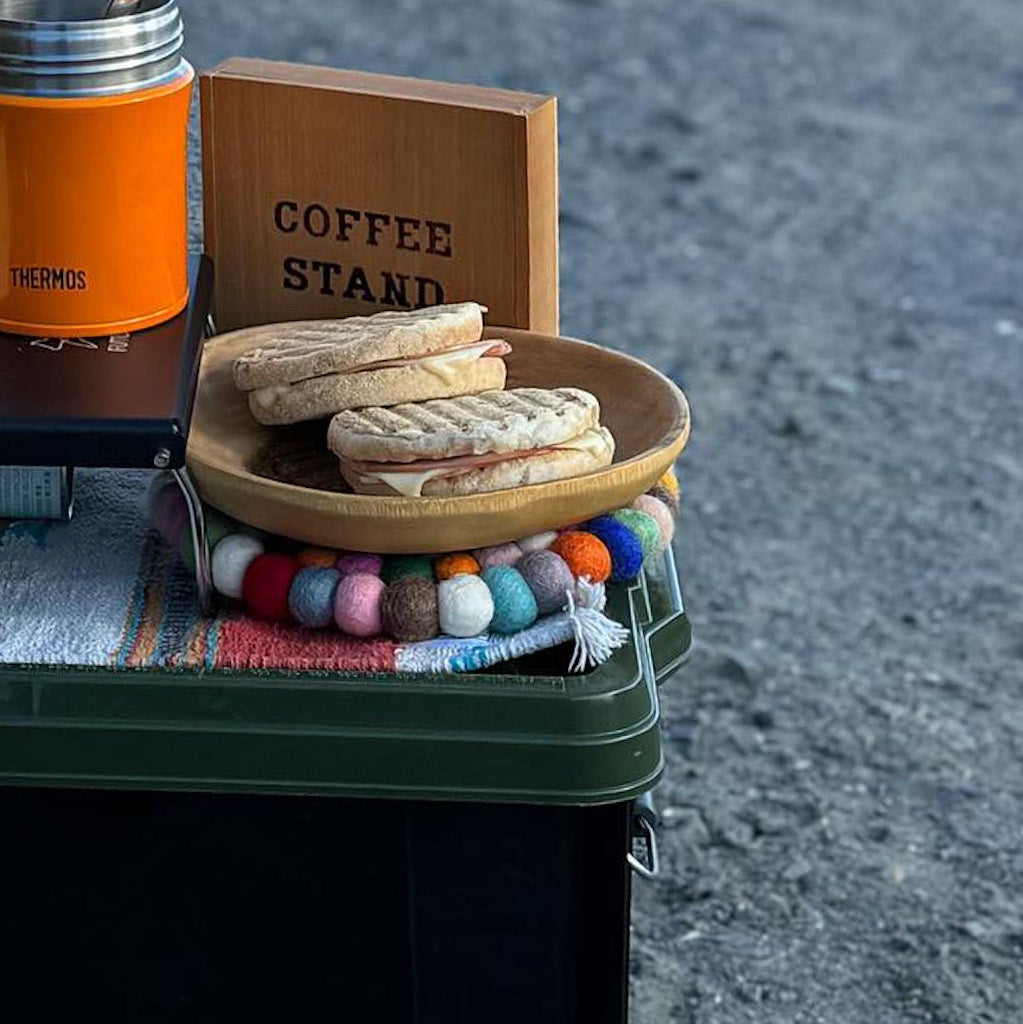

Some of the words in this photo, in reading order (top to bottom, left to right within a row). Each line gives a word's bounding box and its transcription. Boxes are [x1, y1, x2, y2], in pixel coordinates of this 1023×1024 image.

[274, 200, 453, 258] COFFEE
[10, 267, 87, 290] THERMOS
[282, 256, 447, 310] STAND
